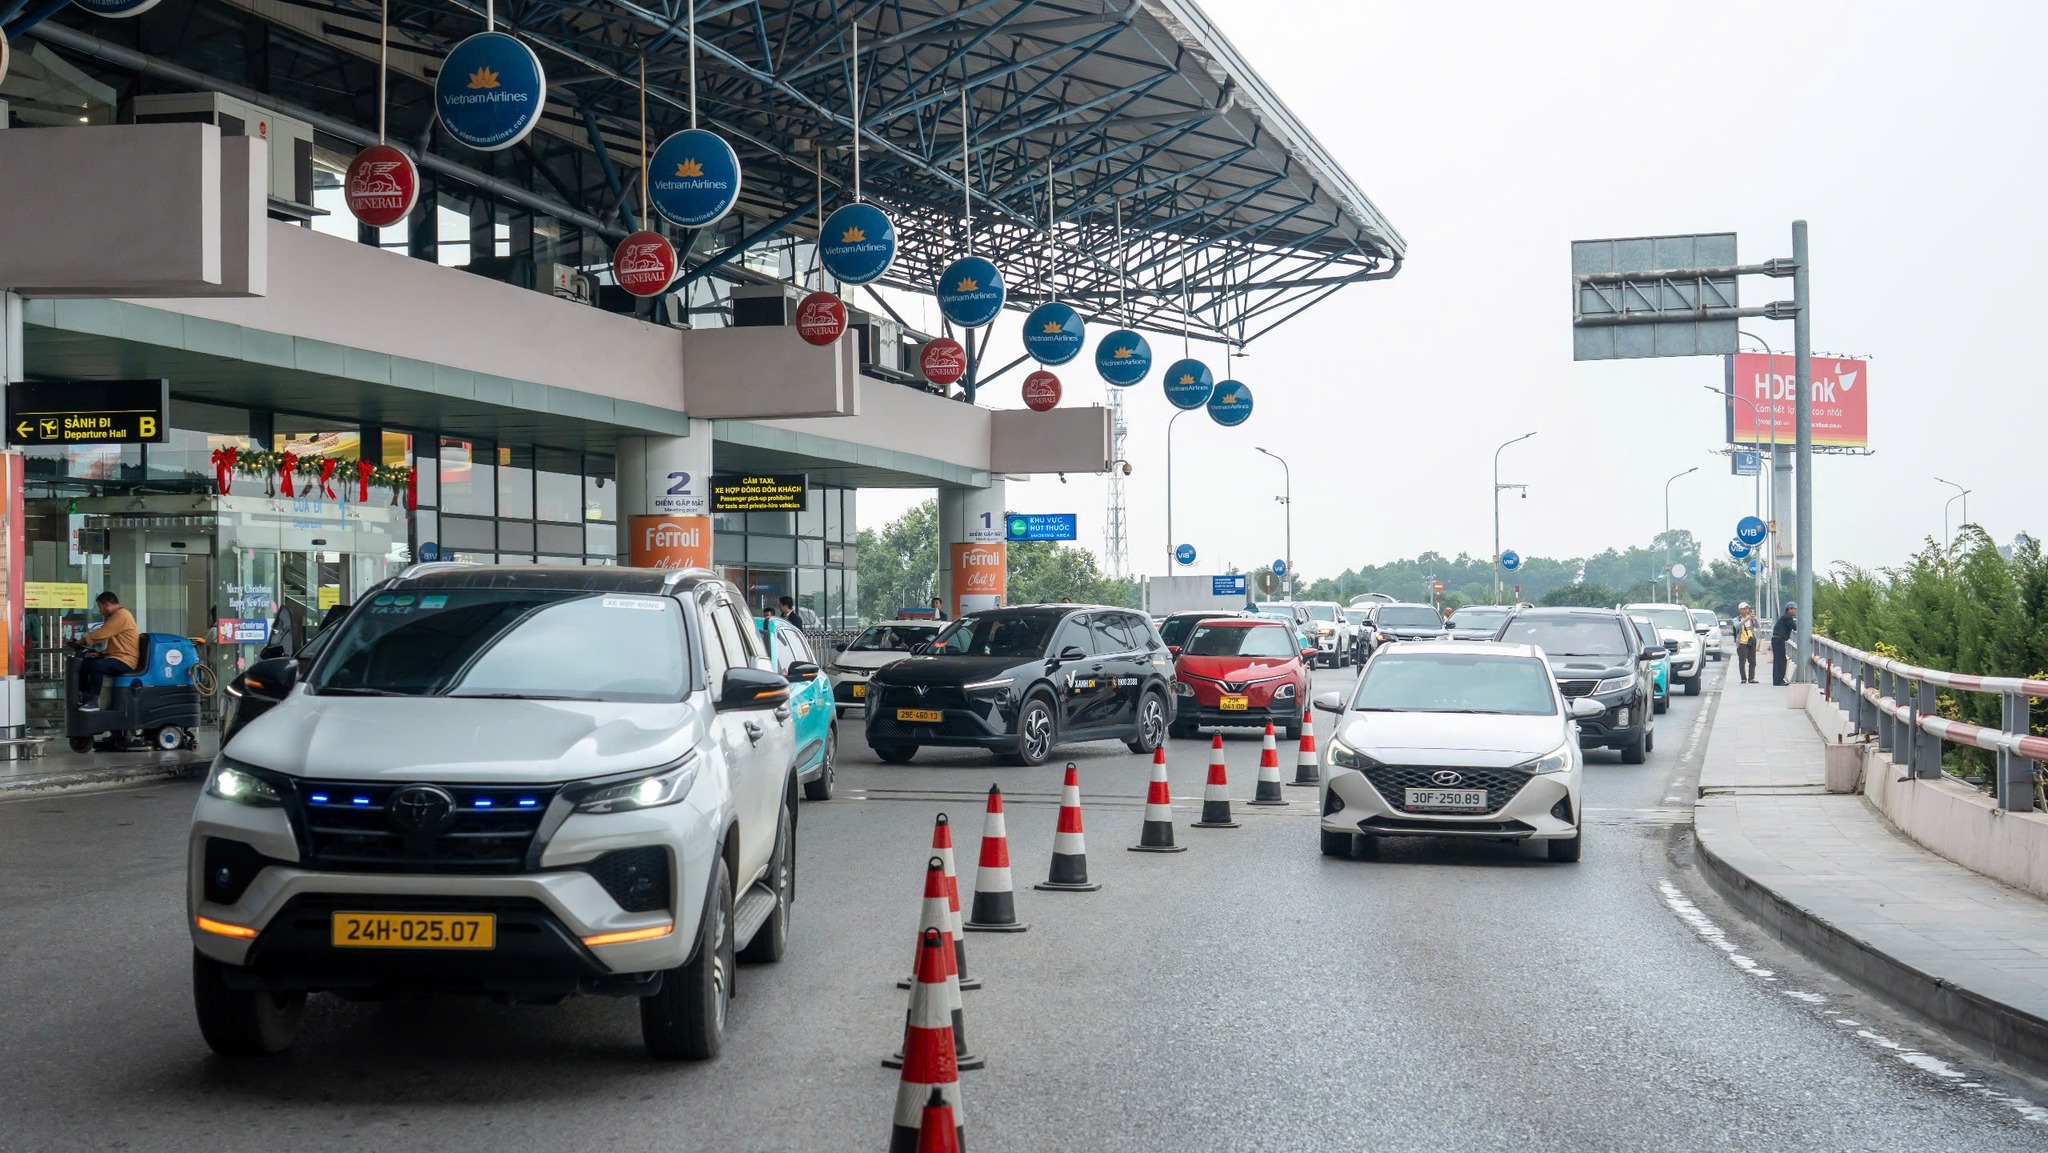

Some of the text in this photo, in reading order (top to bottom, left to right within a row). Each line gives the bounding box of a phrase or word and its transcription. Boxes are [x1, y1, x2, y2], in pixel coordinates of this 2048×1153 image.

[445, 92, 527, 105] Vietnam Airlines
[446, 113, 527, 143] www.vietnamairlines.com
[655, 180, 727, 189] Vietnam Airlines
[352, 197, 402, 209] GENERALI
[656, 199, 726, 222] www.vietnamairlines.com
[825, 244, 886, 255] Vietnam Airlines
[621, 272, 665, 284] GENERALI
[802, 326, 839, 335] GENERALI
[926, 368, 959, 376] GENERALI
[1755, 373, 1836, 403] HDBnk
[64, 415, 157, 437] SẢNH ĐI B
[64, 429, 127, 440] Departure Hall
[667, 472, 691, 495] 2
[741, 485, 760, 493] ĐỒNG
[778, 485, 801, 493] KHÁCH
[655, 497, 673, 506] ĐIỂM
[980, 512, 991, 528] 1
[1045, 523, 1070, 531] THUỐC
[1740, 528, 1757, 537] VIB
[645, 524, 699, 551] Ferroli
[962, 549, 999, 568] Ferroli
[1074, 679, 1088, 688] XANH
[1412, 792, 1480, 805] 30F-250.89
[347, 919, 479, 942] 24H-025.07
